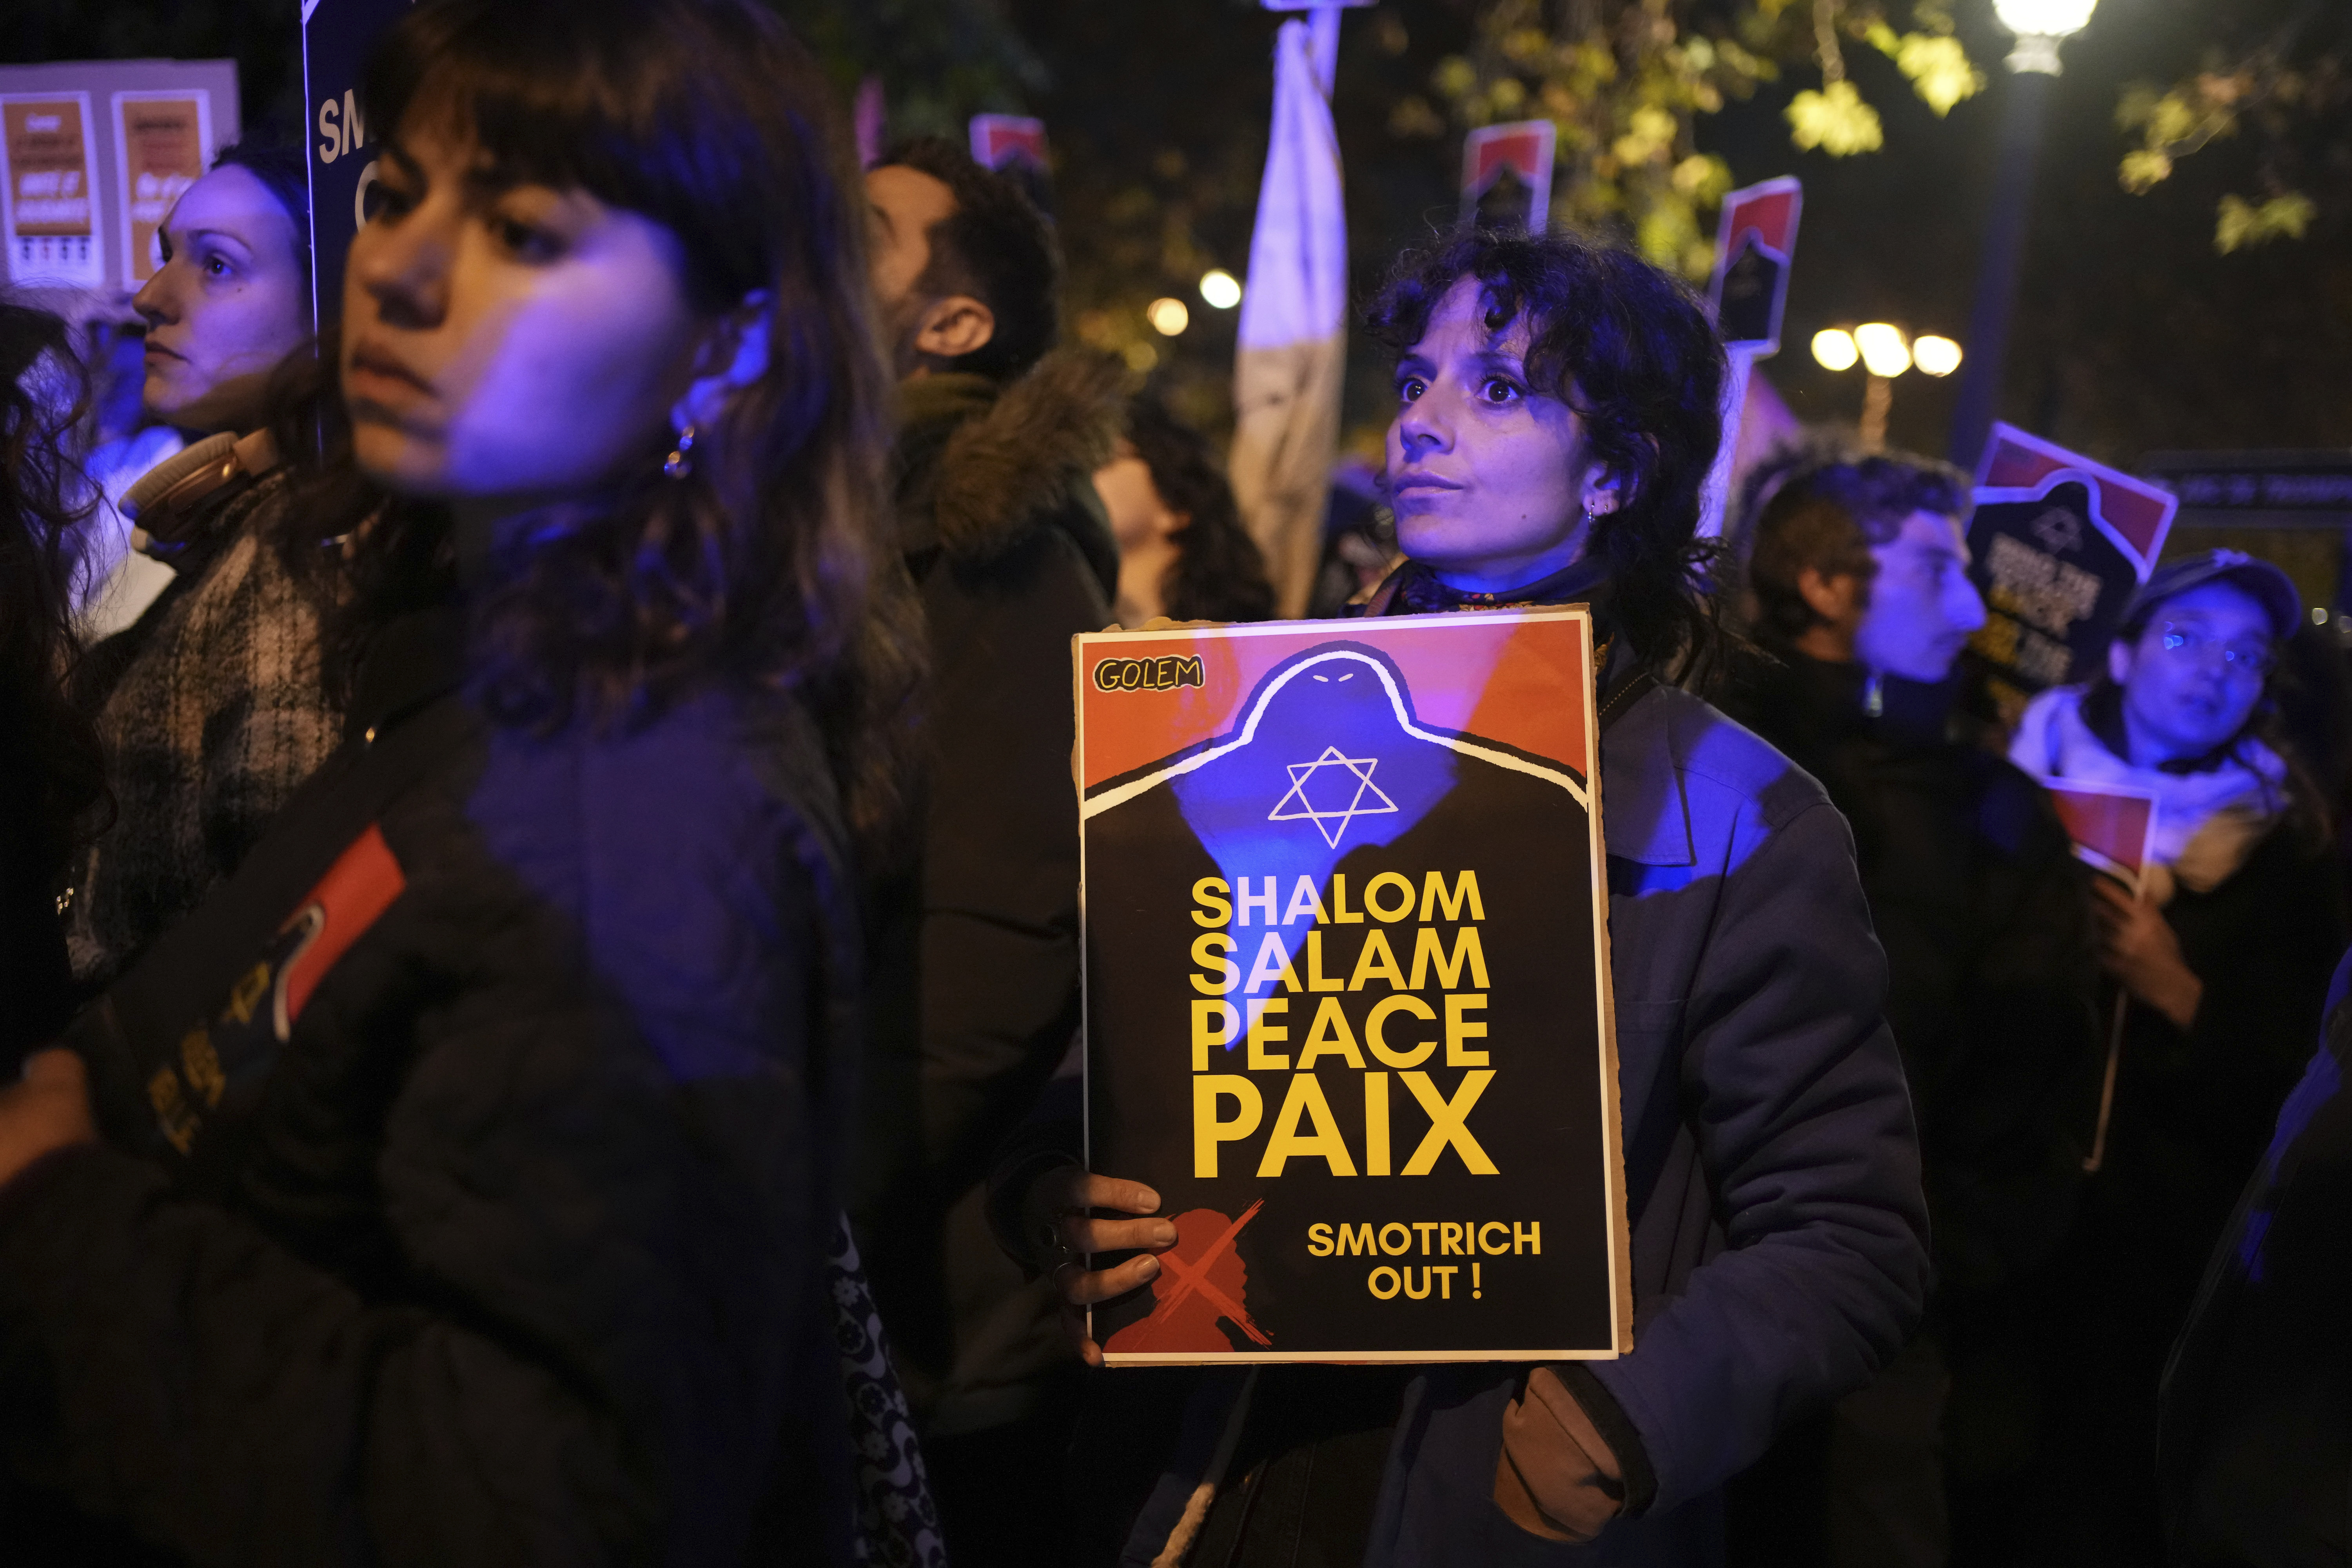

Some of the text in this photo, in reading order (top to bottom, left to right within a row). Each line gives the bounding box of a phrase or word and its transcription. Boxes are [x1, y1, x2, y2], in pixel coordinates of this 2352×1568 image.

[1100, 661, 1200, 689] GOLEM
[1191, 870, 1486, 928] SHALOM
[1189, 927, 1490, 996] SALAM
[1191, 993, 1490, 1072] PEACE
[1193, 1070, 1501, 1178] PAIX
[1307, 1221, 1541, 1257] SMOTRICH
[1368, 1266, 1459, 1300] OUT
